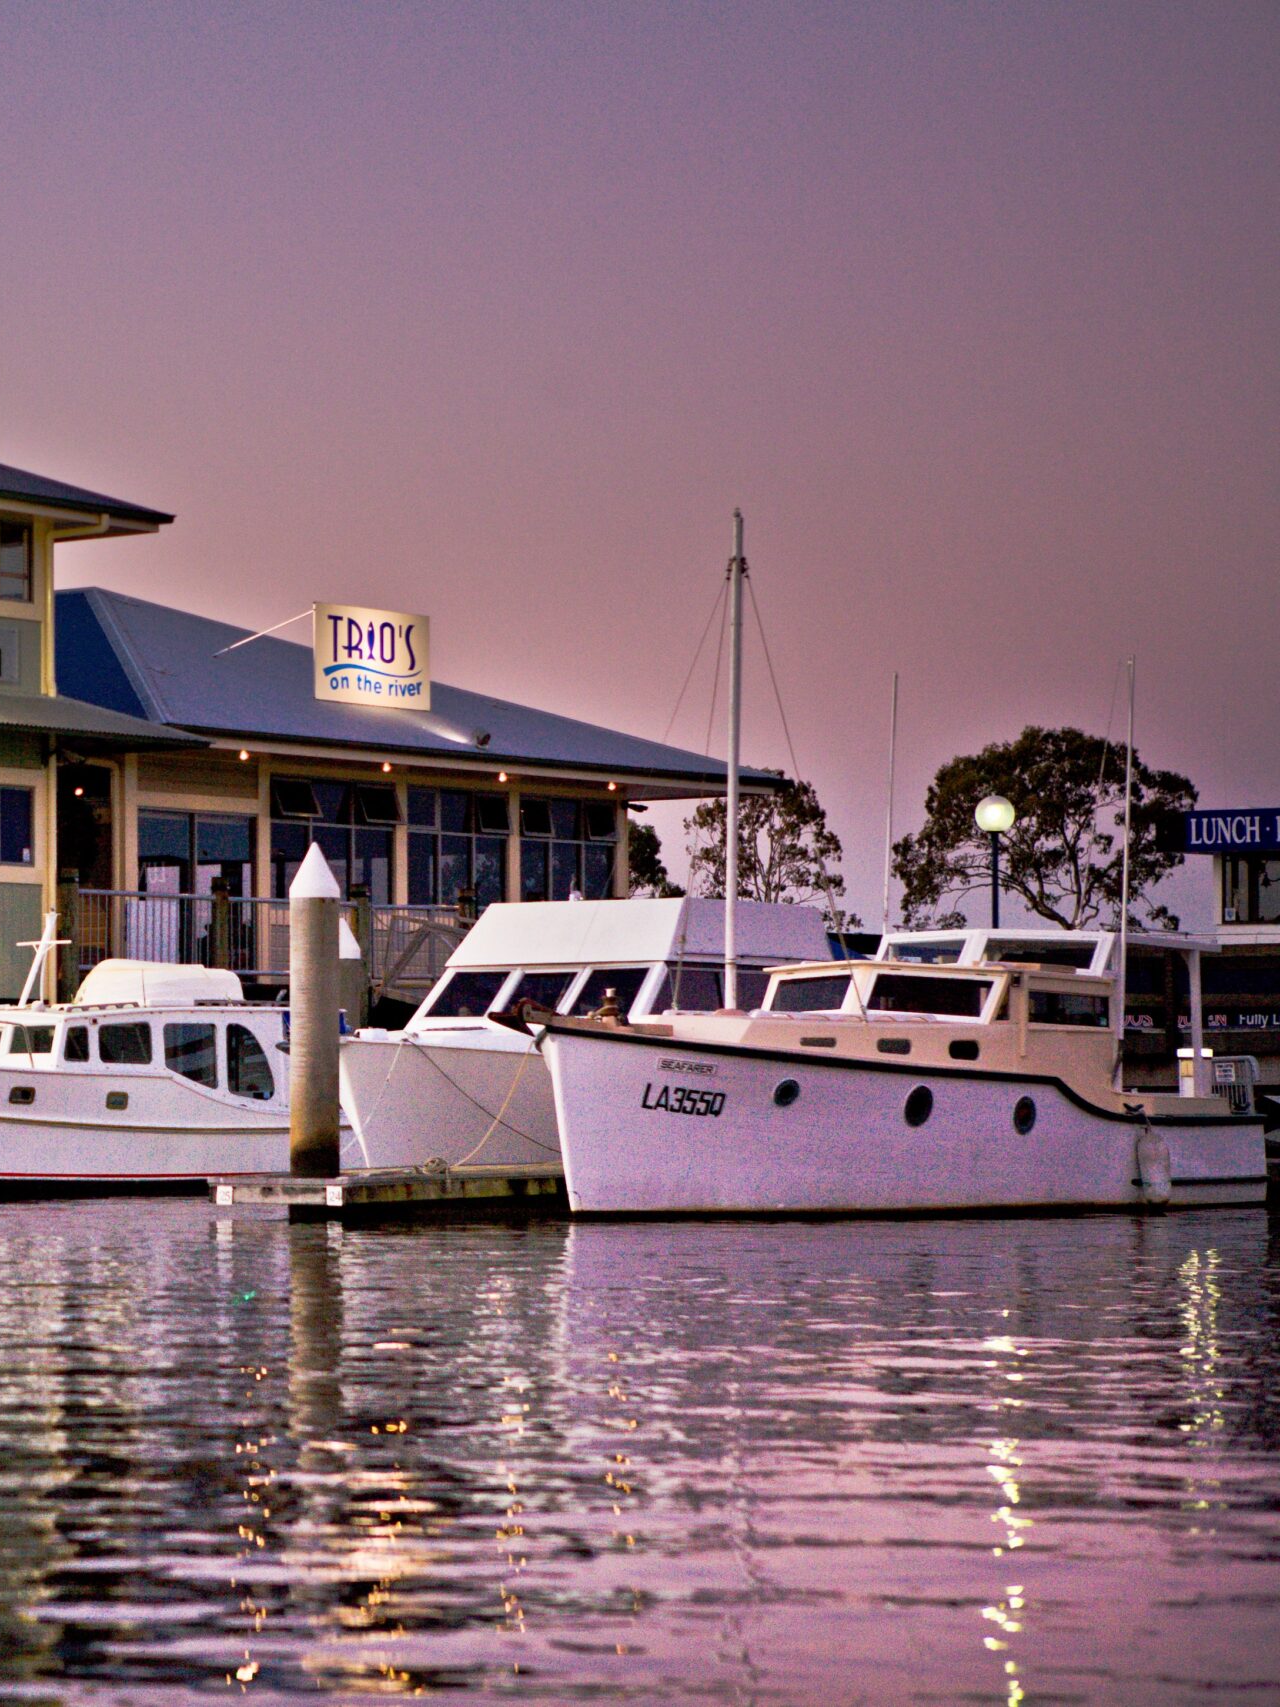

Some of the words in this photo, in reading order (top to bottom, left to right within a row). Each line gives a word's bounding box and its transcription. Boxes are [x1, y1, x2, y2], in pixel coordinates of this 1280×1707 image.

[327, 614, 416, 671] TRIO'S
[330, 676, 350, 690] on
[357, 675, 382, 694] the
[389, 680, 422, 697] river
[1190, 815, 1261, 845] LUNCH
[660, 1060, 715, 1074] SEAFARER
[641, 1082, 727, 1118] LA355Q
